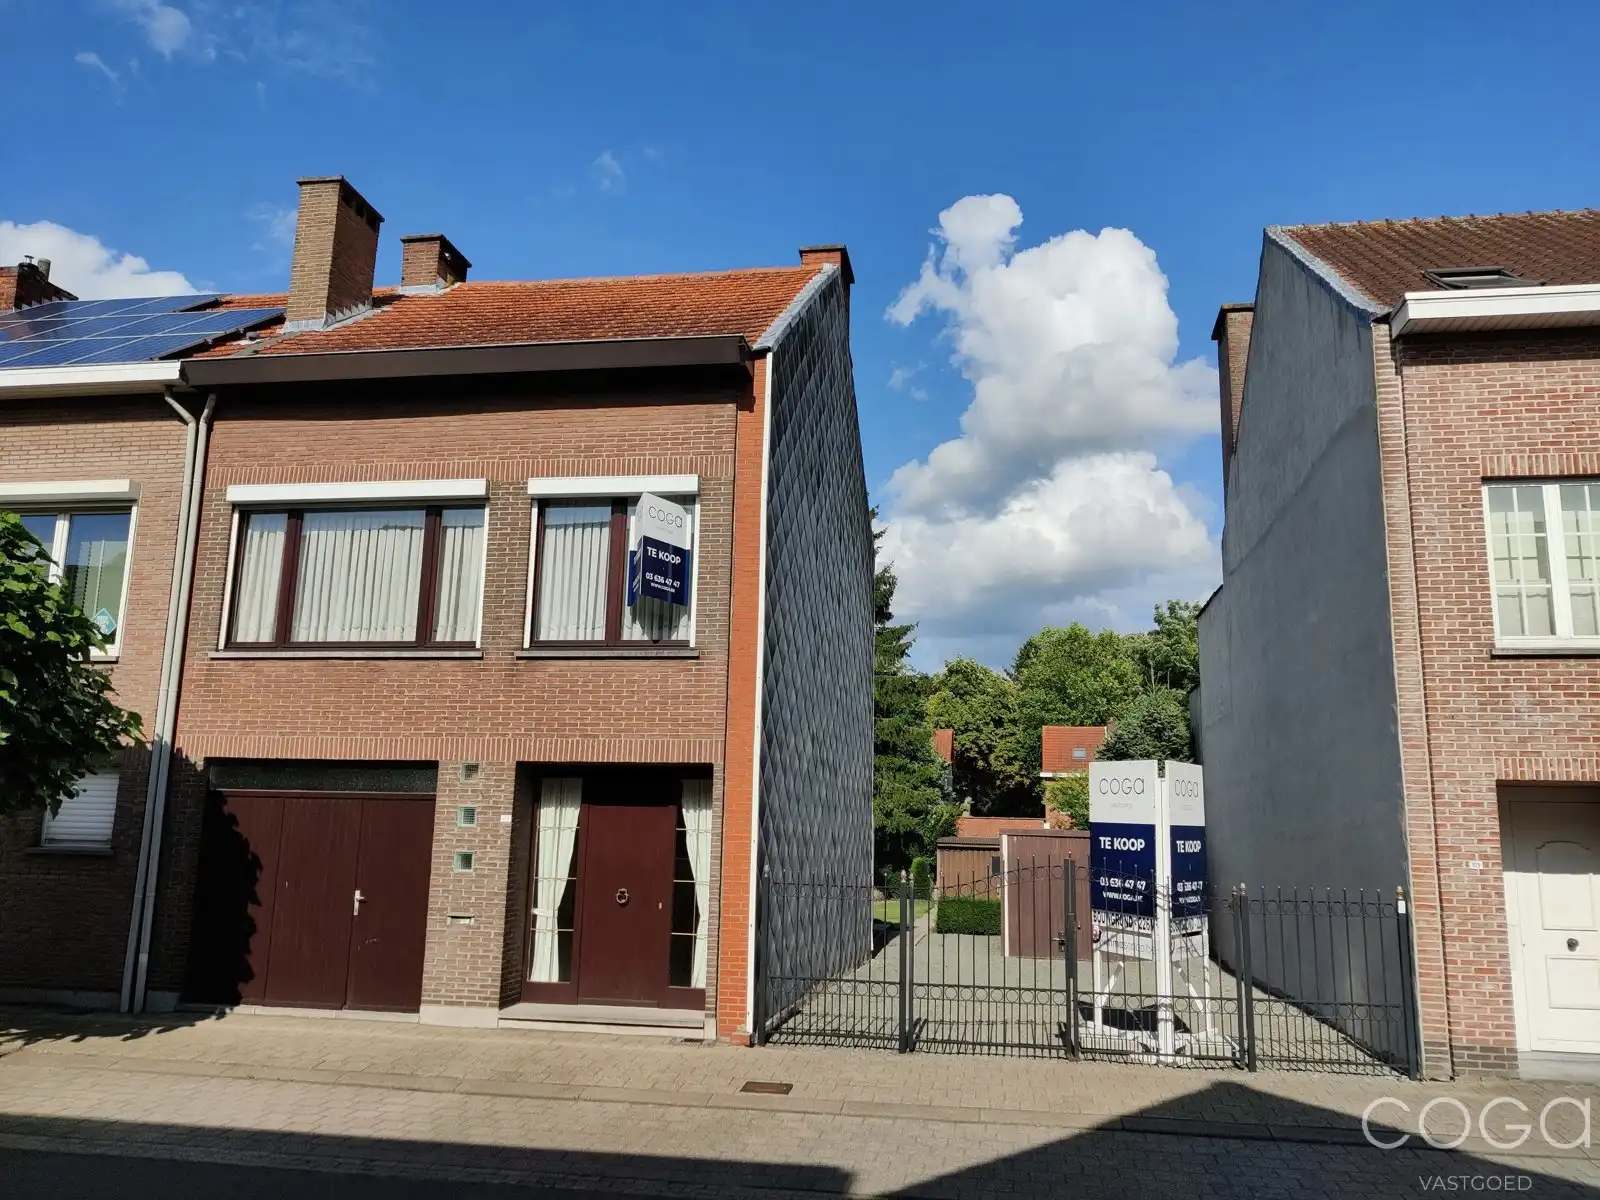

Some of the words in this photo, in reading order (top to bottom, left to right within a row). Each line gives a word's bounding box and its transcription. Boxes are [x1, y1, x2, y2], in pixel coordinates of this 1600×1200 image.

[646, 546, 657, 558] TE
[659, 550, 682, 565] KOOP
[645, 572, 653, 580] 03
[654, 574, 665, 584] 636
[665, 578, 673, 586] 47
[673, 580, 681, 588] 47
[1099, 836, 1112, 850] TE
[1113, 837, 1146, 852] KOOP
[1176, 840, 1185, 853] TE
[1185, 840, 1202, 853] KOOP
[1124, 879, 1134, 889] 47
